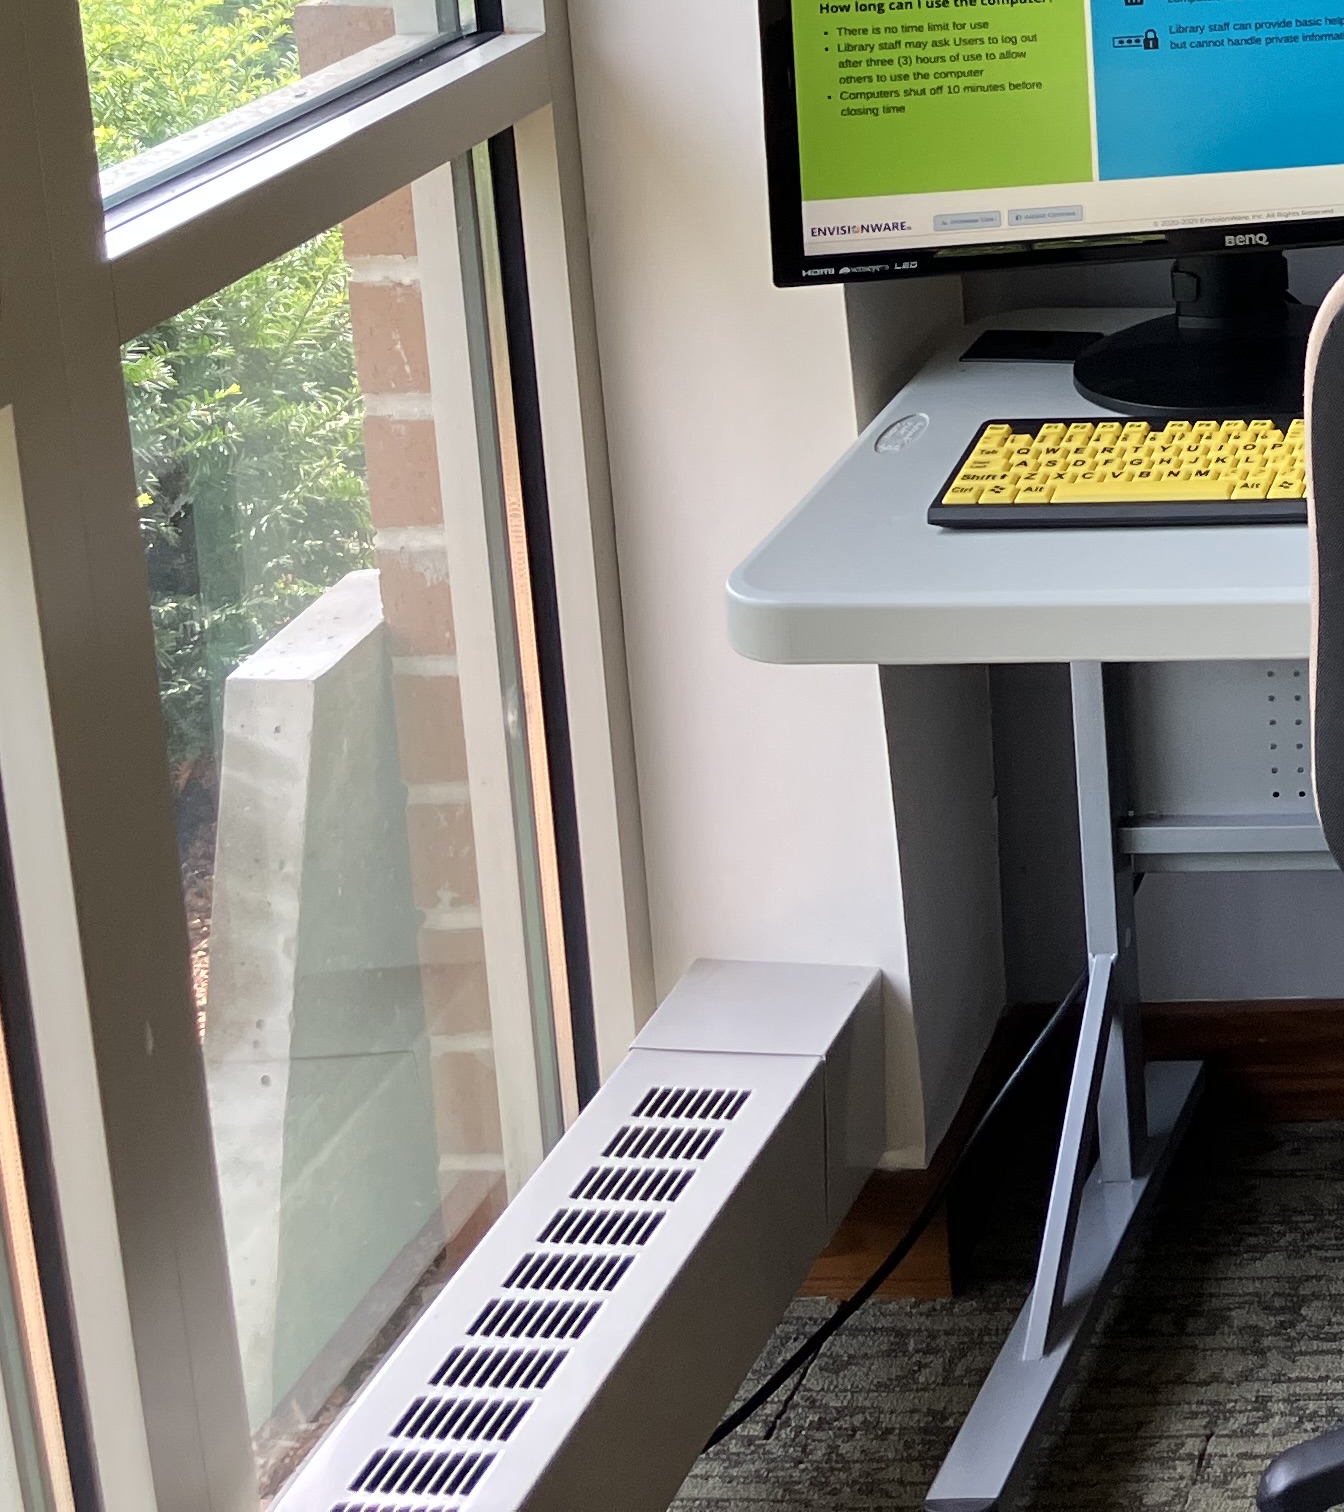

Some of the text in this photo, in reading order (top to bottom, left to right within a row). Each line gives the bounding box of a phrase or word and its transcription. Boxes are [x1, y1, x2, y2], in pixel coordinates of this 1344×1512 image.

[819, 2, 851, 15] How
[854, 0, 886, 15] long
[888, 1, 913, 11] can
[925, 0, 950, 9] use
[835, 21, 989, 37] There is no time limit for use
[1168, 24, 1206, 35] Library
[1207, 21, 1231, 33] staff
[1232, 22, 1252, 31] can
[1254, 18, 1293, 32] provide
[1294, 17, 1323, 28] basic
[838, 69, 984, 85] others to use the computer
